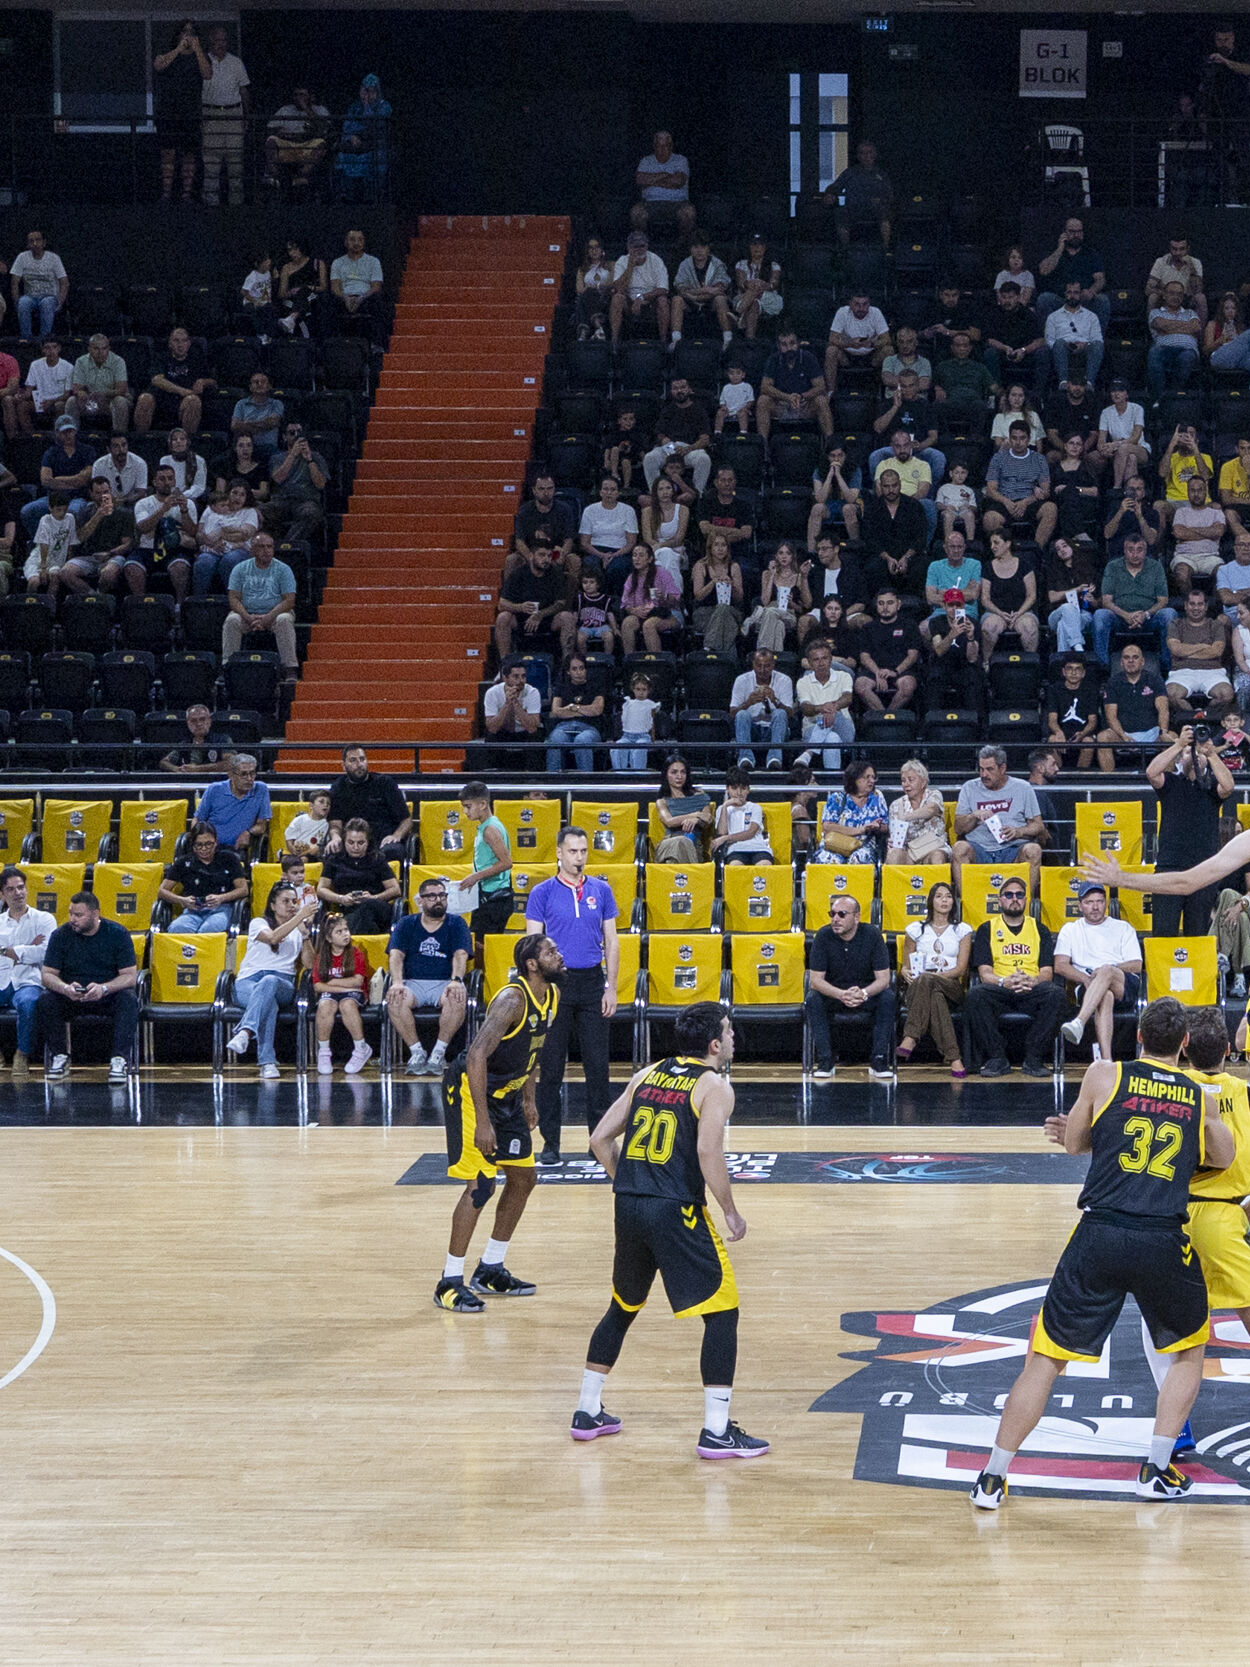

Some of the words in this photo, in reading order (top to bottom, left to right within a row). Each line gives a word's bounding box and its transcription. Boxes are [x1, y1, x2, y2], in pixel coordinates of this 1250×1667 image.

[1036, 43, 1070, 60] G-1
[1024, 67, 1081, 84] BLOK
[1002, 943, 1031, 955] MSK
[1128, 1075, 1196, 1106] HEMPHILL
[626, 1106, 678, 1165] 20
[1118, 1116, 1184, 1181] 32
[879, 1391, 1133, 1409] ULBÜ
